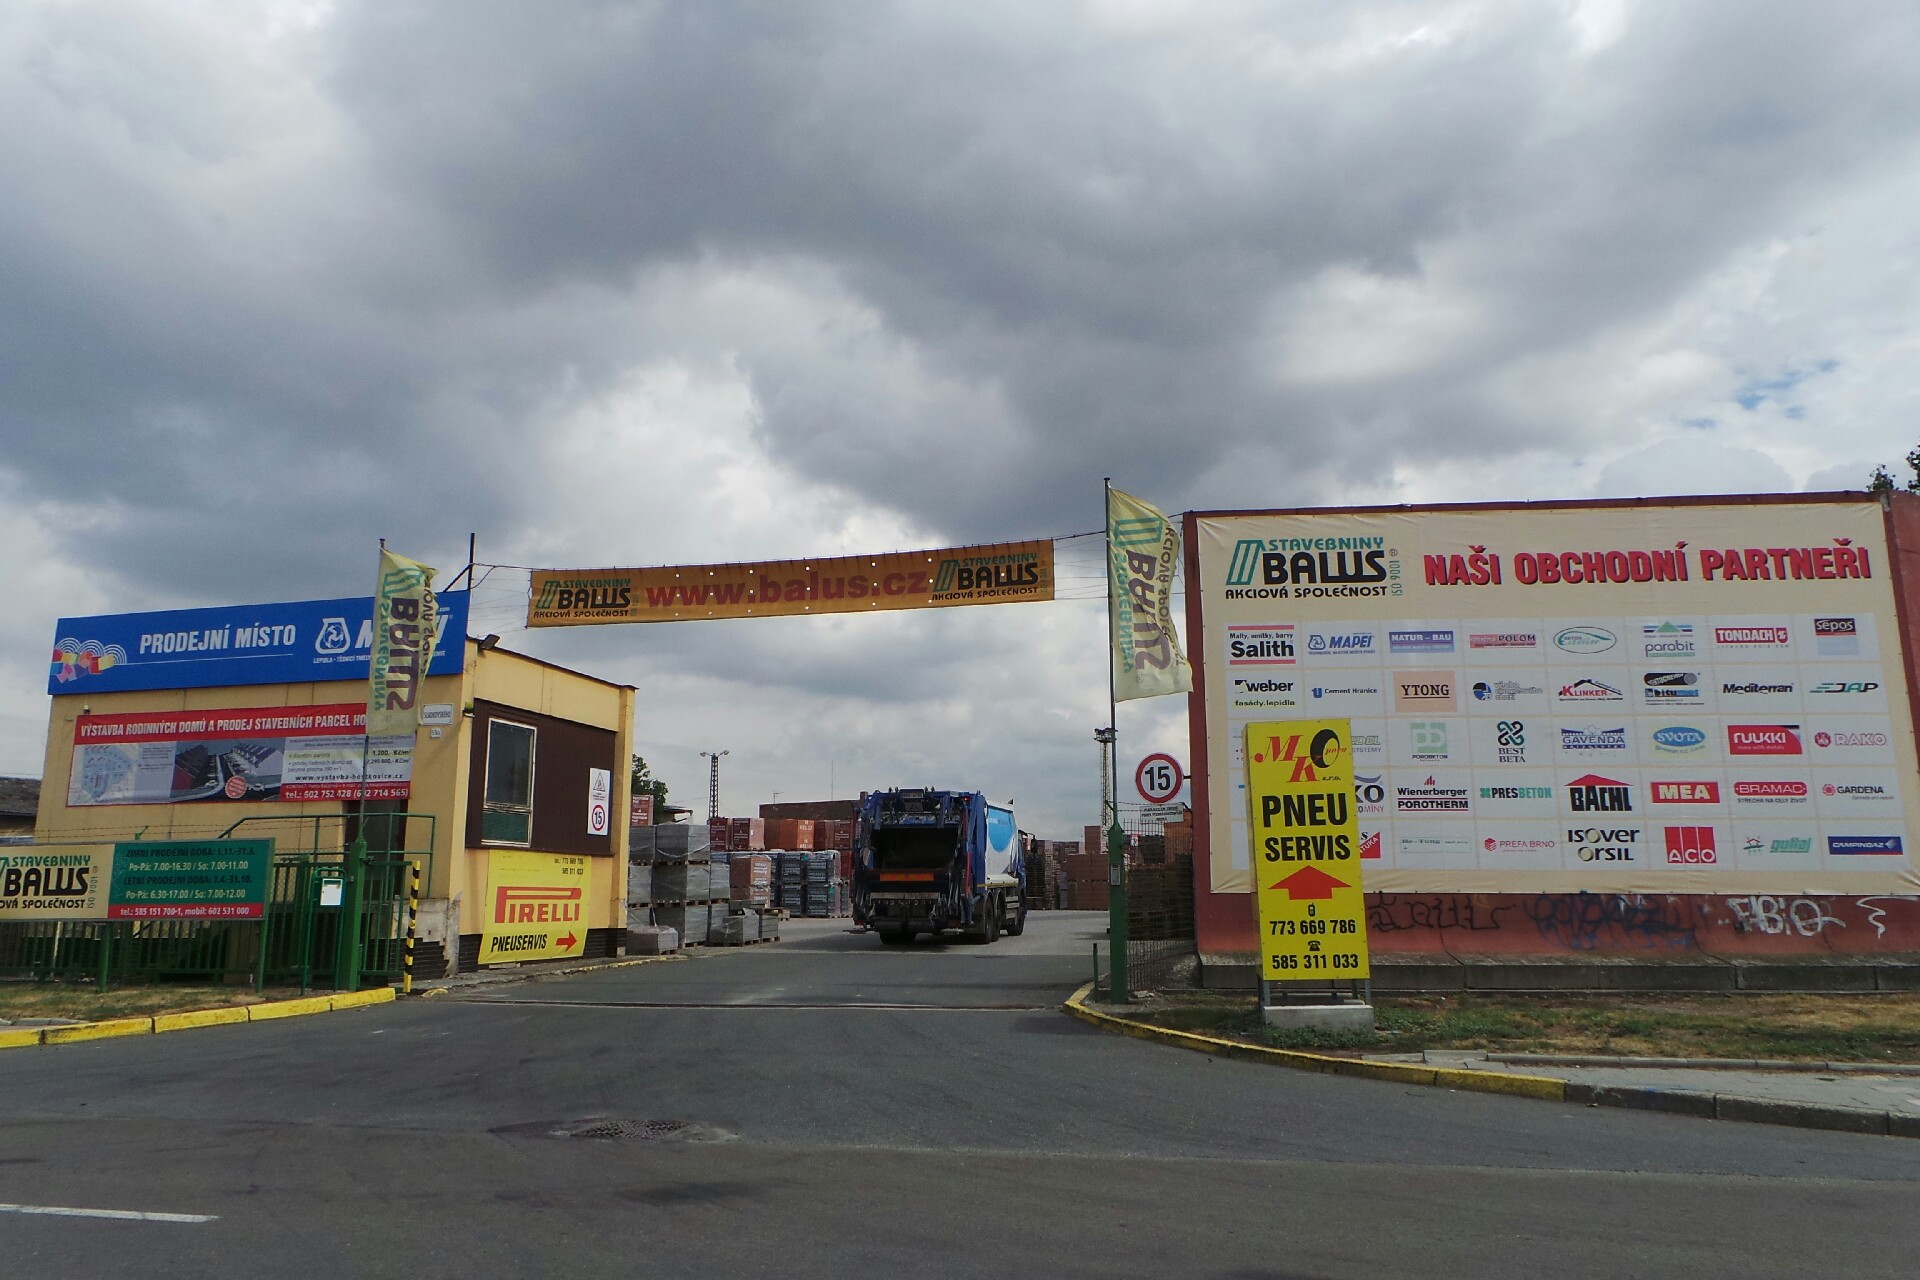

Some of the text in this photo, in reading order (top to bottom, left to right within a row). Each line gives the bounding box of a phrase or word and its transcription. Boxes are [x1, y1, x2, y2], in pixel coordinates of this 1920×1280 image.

[1268, 537, 1384, 551] STAVEBNINY
[962, 552, 1037, 567] STAVEBNINY
[1424, 538, 1872, 585] NAŠI OBCHODNÍ PARTNEŘI
[1262, 550, 1387, 585] BALUS
[958, 562, 1038, 590] BALUS
[1389, 560, 1402, 596] ISO 9001
[562, 579, 631, 588] STAVEBNINY
[645, 571, 927, 607] www.balus.cz
[558, 588, 631, 609] BALUS
[932, 587, 1038, 600] AKCIOVÁ SPOLEČNOST
[1225, 585, 1388, 600] AKCIOVÁ SPOLEČNOST
[534, 609, 629, 618] AKCIOVÁ SPOLEČNOST
[1816, 619, 1853, 632] sepos
[140, 622, 296, 654] PRODEJNÍ MÍSTO
[1329, 636, 1372, 648] MAPEI
[1498, 634, 1536, 642] POLOM
[1717, 630, 1774, 641] TONDACH
[1231, 640, 1294, 658] Salith
[1645, 640, 1695, 657] parabit
[1247, 680, 1294, 692] weber
[1401, 684, 1449, 696] YTONG
[1562, 686, 1607, 697] KLINKER
[1723, 683, 1793, 694] Mediterran
[1825, 683, 1879, 693] JAP
[81, 714, 350, 737] VÝSTAVBA RODINNÝCH DOMŮ A PRODEJ STAVEBNÍCH PARCEL
[1562, 736, 1625, 744] GAVENDA
[1657, 732, 1702, 742] SVOTA
[1734, 732, 1786, 744] ruukki
[1834, 733, 1887, 746] RAKO
[1145, 766, 1171, 791] 15
[286, 791, 301, 799] tel.:
[321, 790, 335, 798] 752
[373, 789, 389, 797] 714
[391, 789, 408, 797] 565)
[1397, 788, 1468, 797] Wienerberger
[1492, 788, 1552, 799] PRESBETON
[1658, 784, 1711, 800] MEA
[1739, 784, 1804, 794] BRAMAC
[1837, 786, 1884, 794] GARDENA
[1262, 793, 1348, 828] PNEU
[1358, 803, 1384, 813] OMÍNY
[1398, 800, 1468, 809] POROTHERM
[595, 811, 602, 825] 15
[1265, 834, 1351, 863] SERVIS
[1500, 840, 1555, 848] PREFA BRNO
[12, 855, 90, 867] STAVEBNINY
[1669, 849, 1716, 862] ACO
[129, 862, 151, 871] Po-Pá:
[154, 861, 191, 871] 7.00-16.30
[198, 862, 209, 870] So:
[211, 861, 248, 870] 7.00-11.00
[3, 868, 89, 896] BALUS
[126, 891, 149, 899] Po-Pá:
[151, 890, 189, 899] 6.30-17.00
[195, 890, 206, 899] So:
[208, 889, 246, 898] 7.00-12.00
[22, 898, 85, 908] SPOLEČNOST
[494, 886, 583, 924] PIRELLI
[121, 908, 133, 916] tel.:
[185, 907, 206, 915] mobil:
[208, 907, 221, 915] 602
[1270, 919, 1356, 935] 773 669 786
[491, 933, 548, 953] PNEUSERVIS
[1272, 954, 1358, 970] 585 311 033
